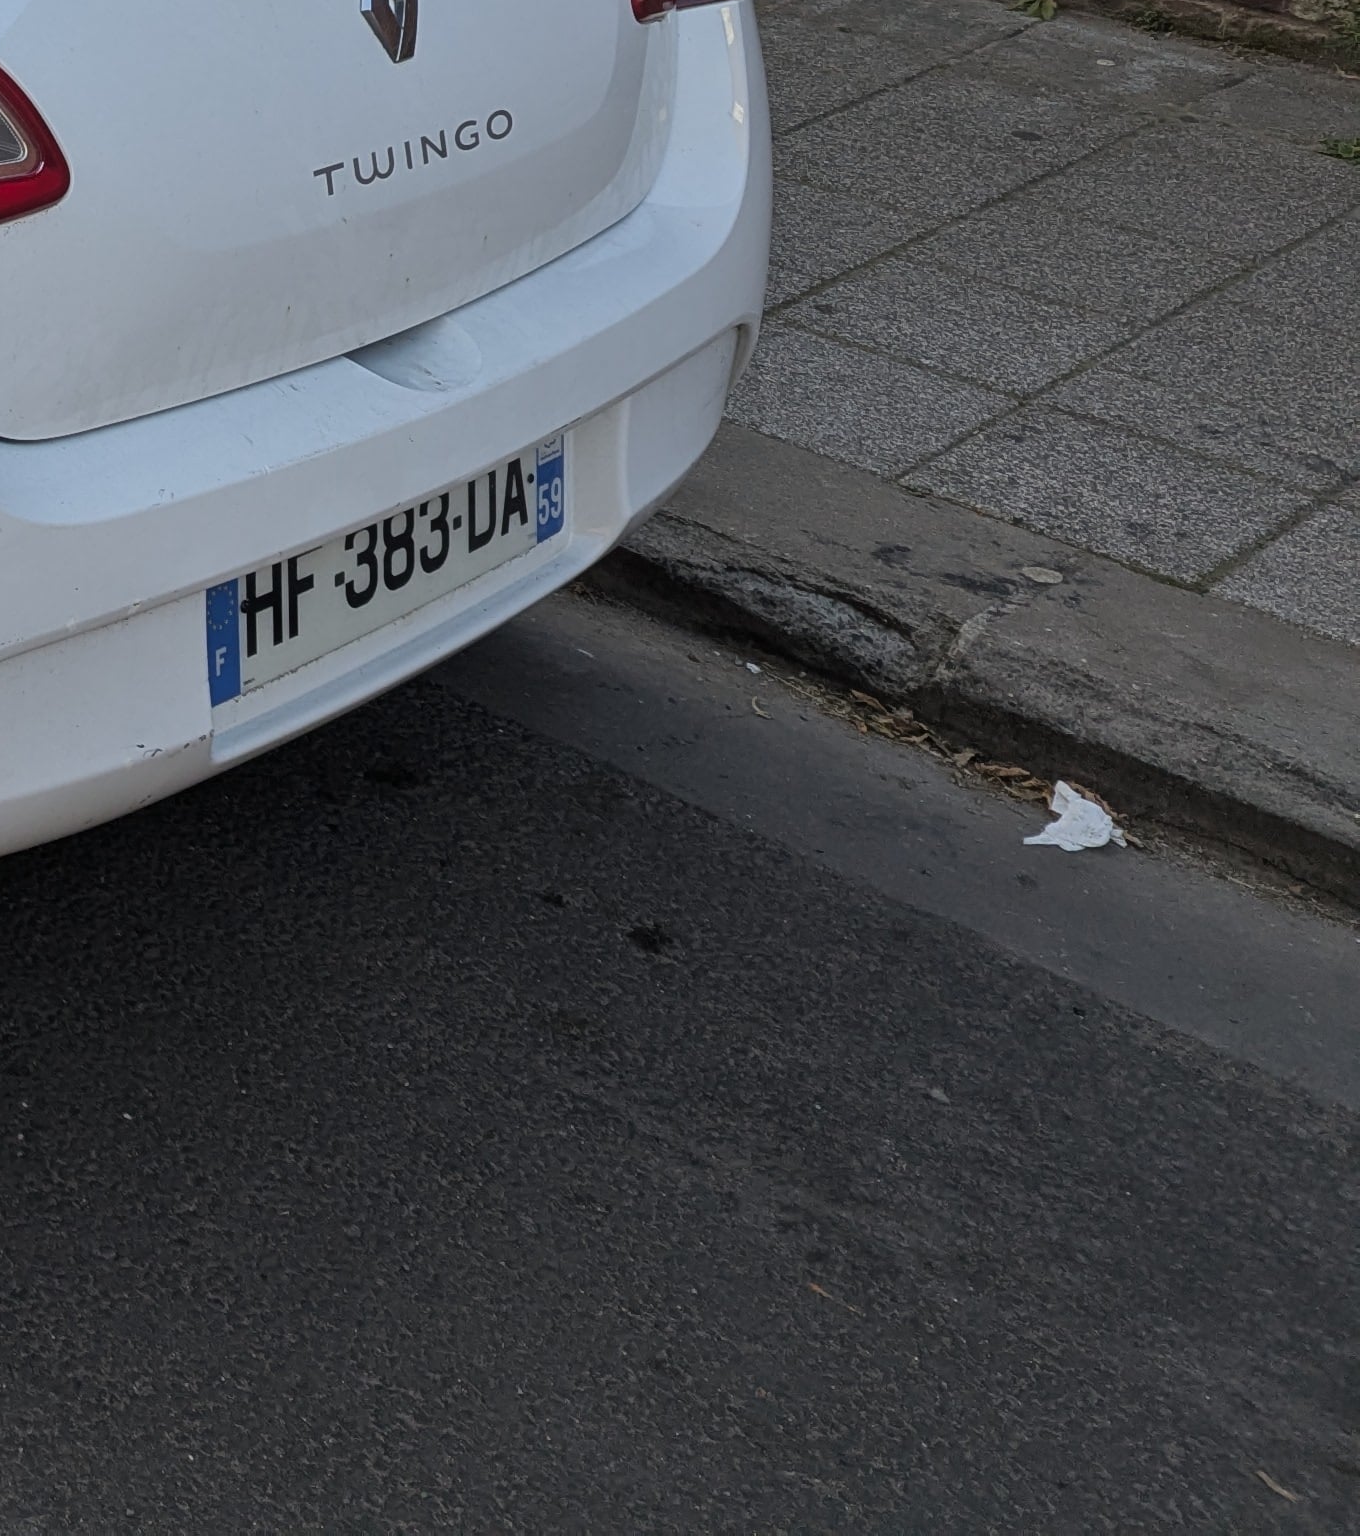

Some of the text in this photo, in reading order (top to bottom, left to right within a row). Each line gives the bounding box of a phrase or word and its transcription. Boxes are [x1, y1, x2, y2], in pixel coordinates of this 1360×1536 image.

[312, 109, 514, 197] TWINGO
[537, 476, 563, 526] 59
[215, 646, 228, 678] F
